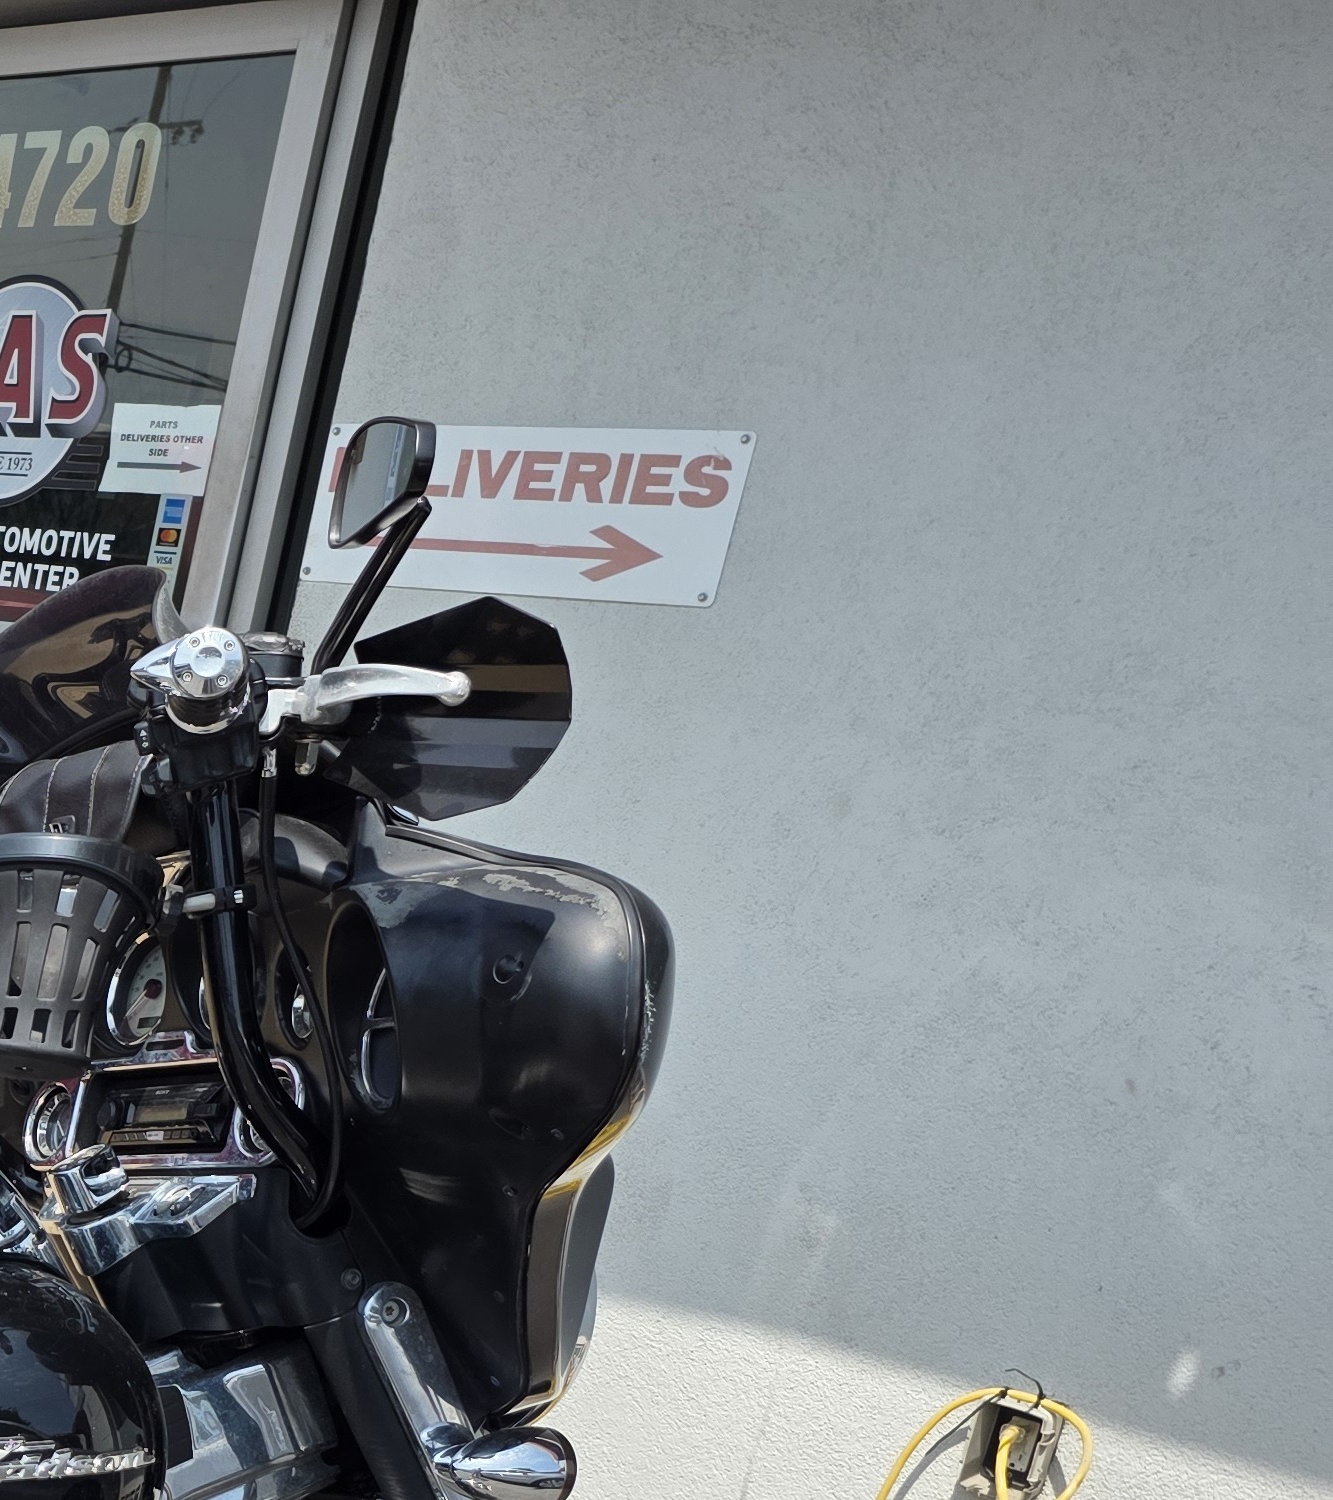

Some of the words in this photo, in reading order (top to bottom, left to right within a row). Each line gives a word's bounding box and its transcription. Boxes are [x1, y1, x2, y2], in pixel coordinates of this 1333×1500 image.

[149, 420, 178, 429] PARTS
[120, 433, 170, 444] DELIVERIES
[172, 435, 203, 444] OTHER
[148, 448, 169, 457] SIDE
[7, 457, 33, 471] 1973
[329, 447, 732, 508] IVERIES
[155, 555, 173, 565] VISA
